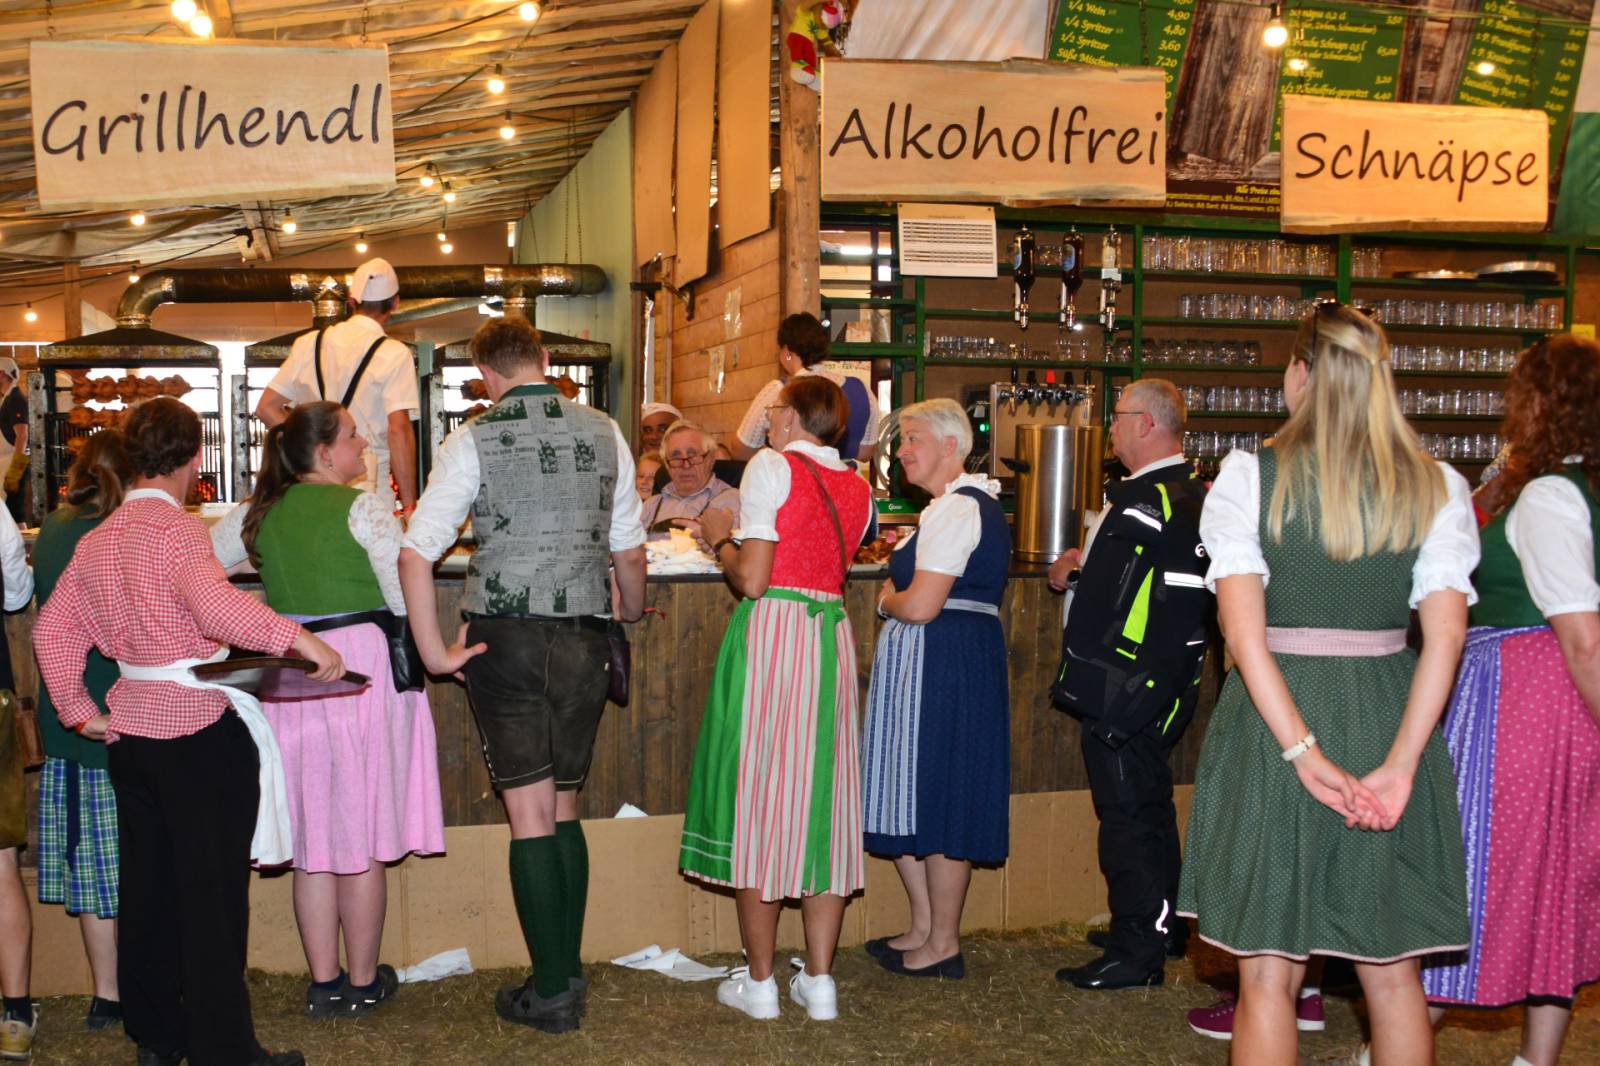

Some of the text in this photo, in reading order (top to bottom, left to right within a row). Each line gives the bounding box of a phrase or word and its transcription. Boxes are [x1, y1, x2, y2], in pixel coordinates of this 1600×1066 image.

[1158, 40, 1181, 51] 3,60
[1163, 24, 1186, 36] 4,80
[1155, 55, 1177, 68] 7,20
[41, 83, 383, 161] Grillhendl
[829, 102, 1163, 165] Alkoholfrei
[1295, 129, 1539, 203] Schnäpse
